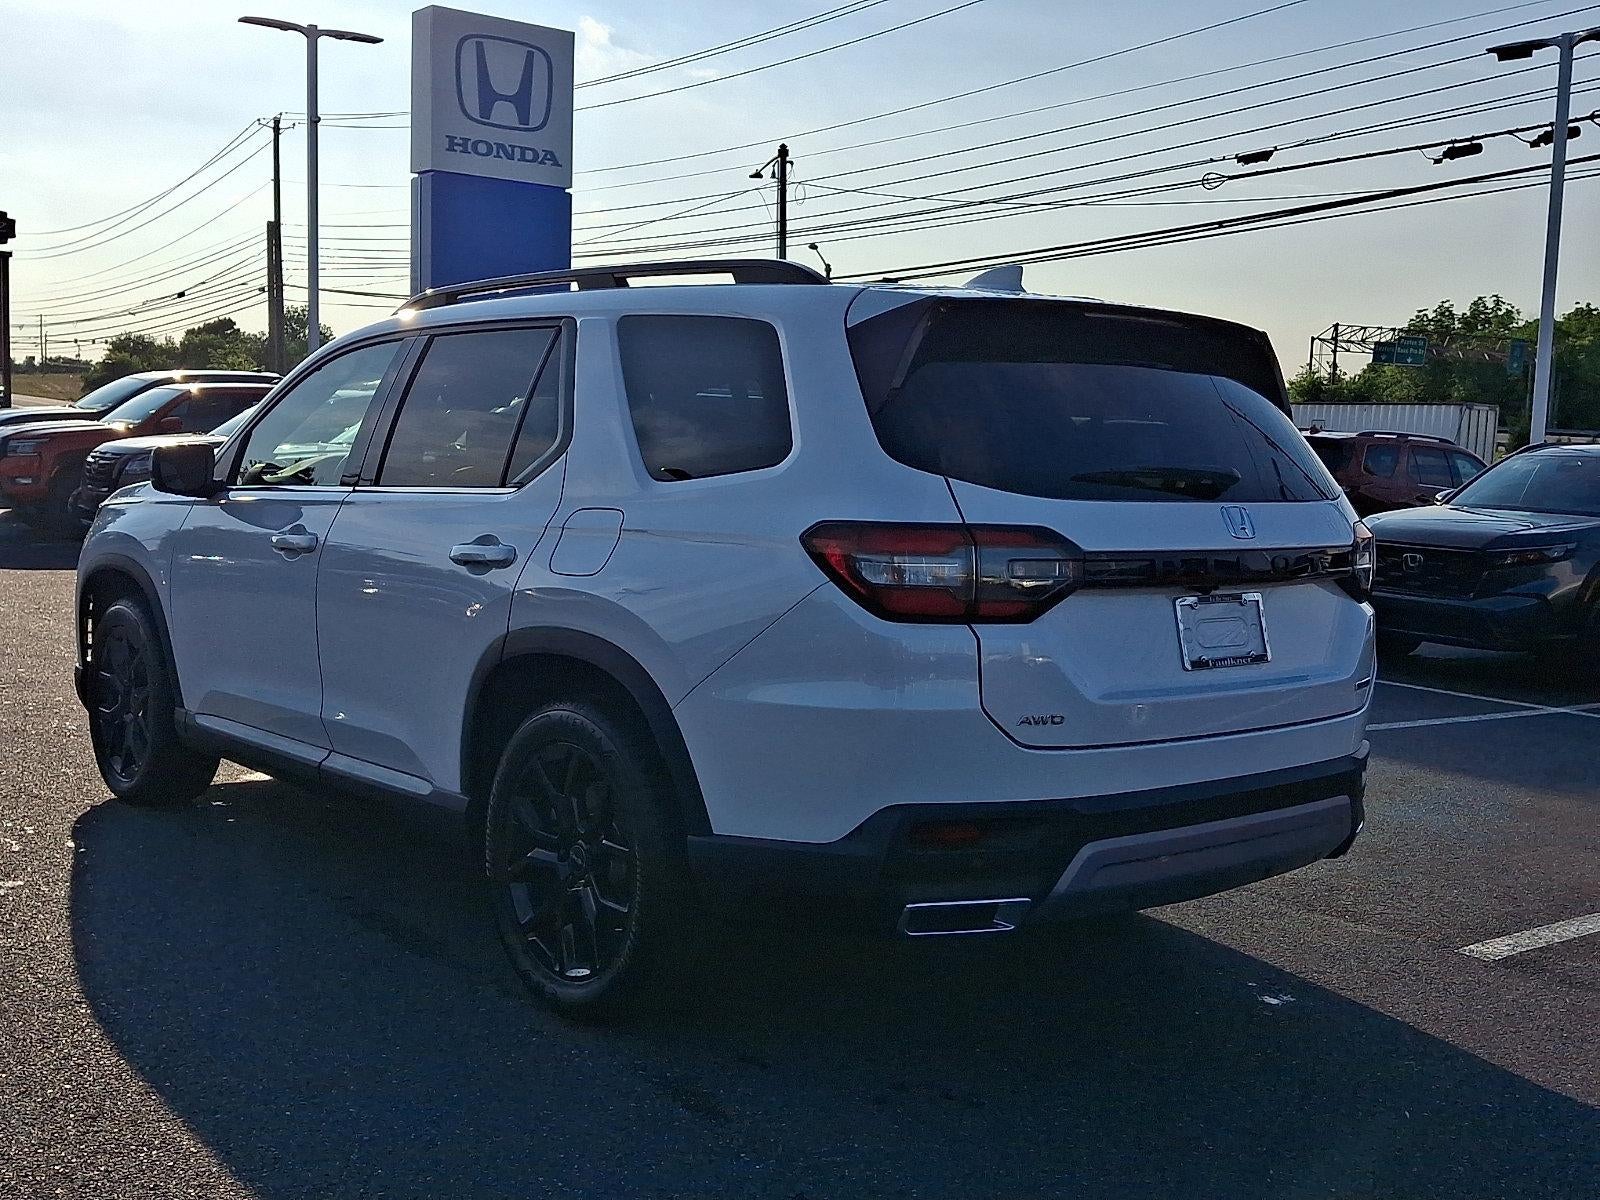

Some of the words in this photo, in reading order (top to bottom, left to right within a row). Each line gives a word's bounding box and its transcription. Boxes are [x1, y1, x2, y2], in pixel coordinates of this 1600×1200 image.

[445, 134, 562, 167] HONDA
[1208, 656, 1253, 667] Faulkner
[1016, 714, 1065, 726] AWD
